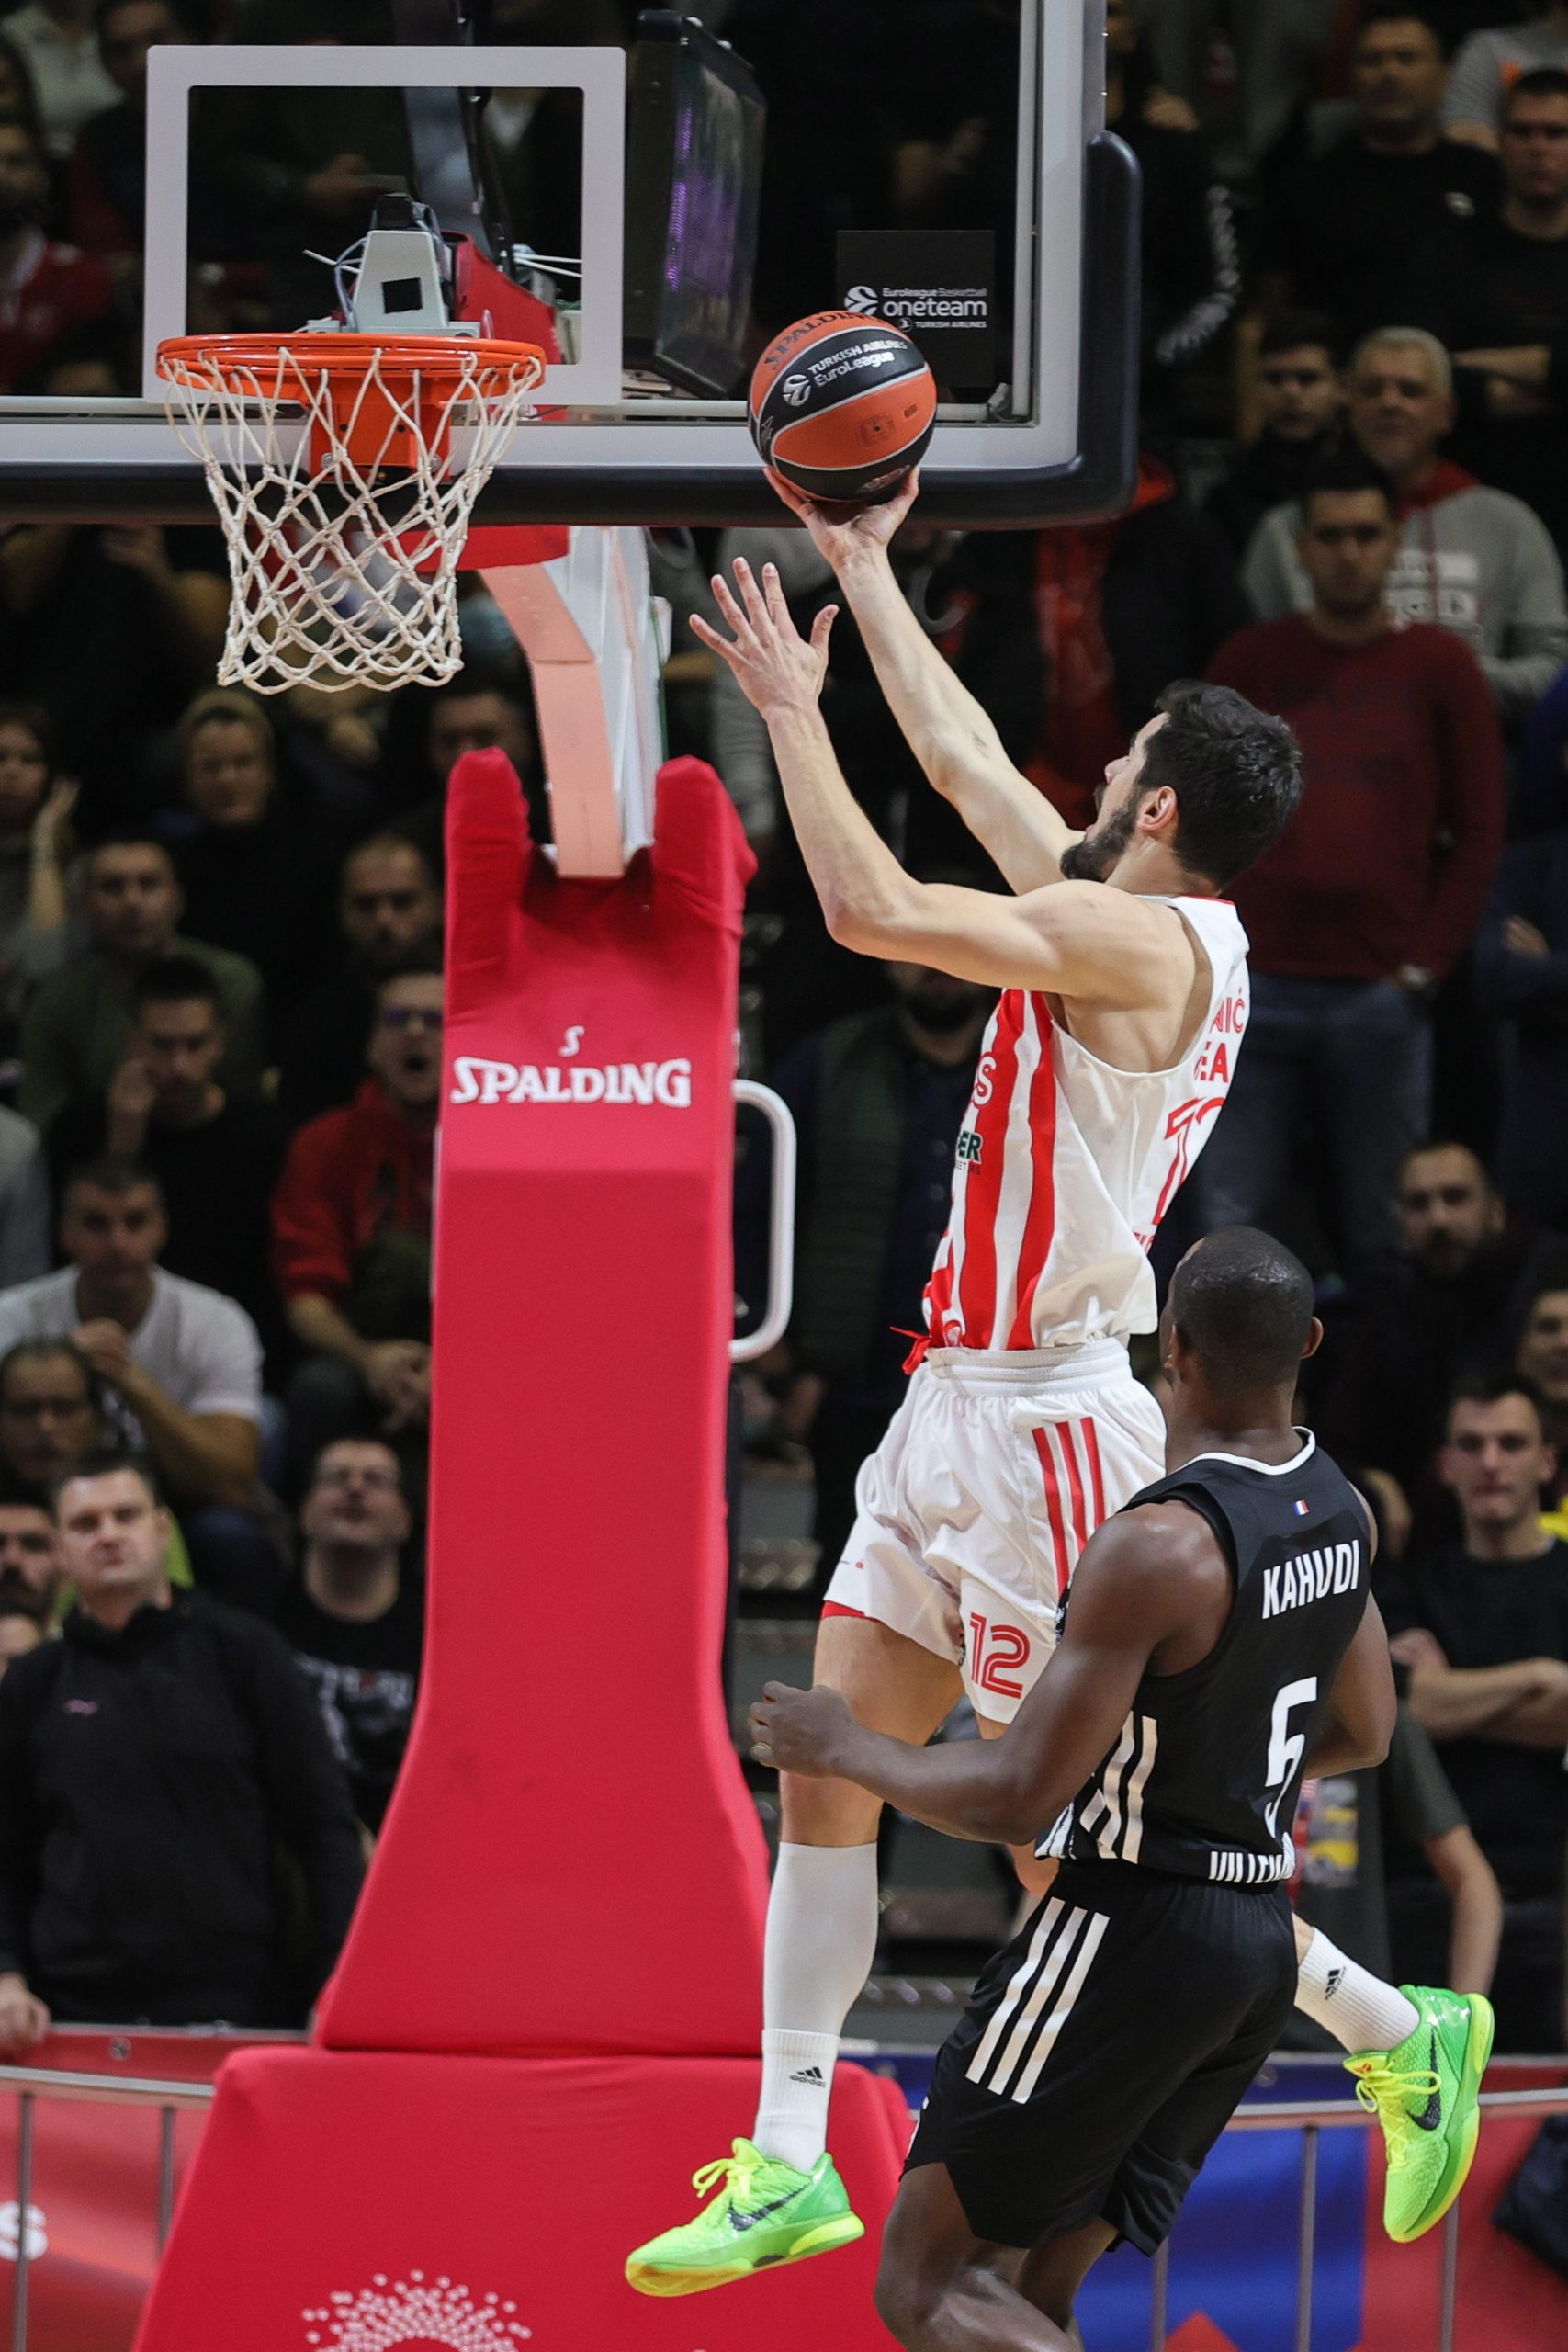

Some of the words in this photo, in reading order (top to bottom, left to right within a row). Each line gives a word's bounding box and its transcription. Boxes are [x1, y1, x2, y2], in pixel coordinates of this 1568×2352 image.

[883, 298, 987, 317] oneteam
[807, 345, 863, 374] TURKISH
[863, 340, 908, 353] AIRLINES
[814, 351, 896, 386] EuroLeague
[450, 1056, 692, 1108] SPALDING
[1262, 1539, 1360, 1620] KAHUDI
[970, 1612, 1031, 1700] 12
